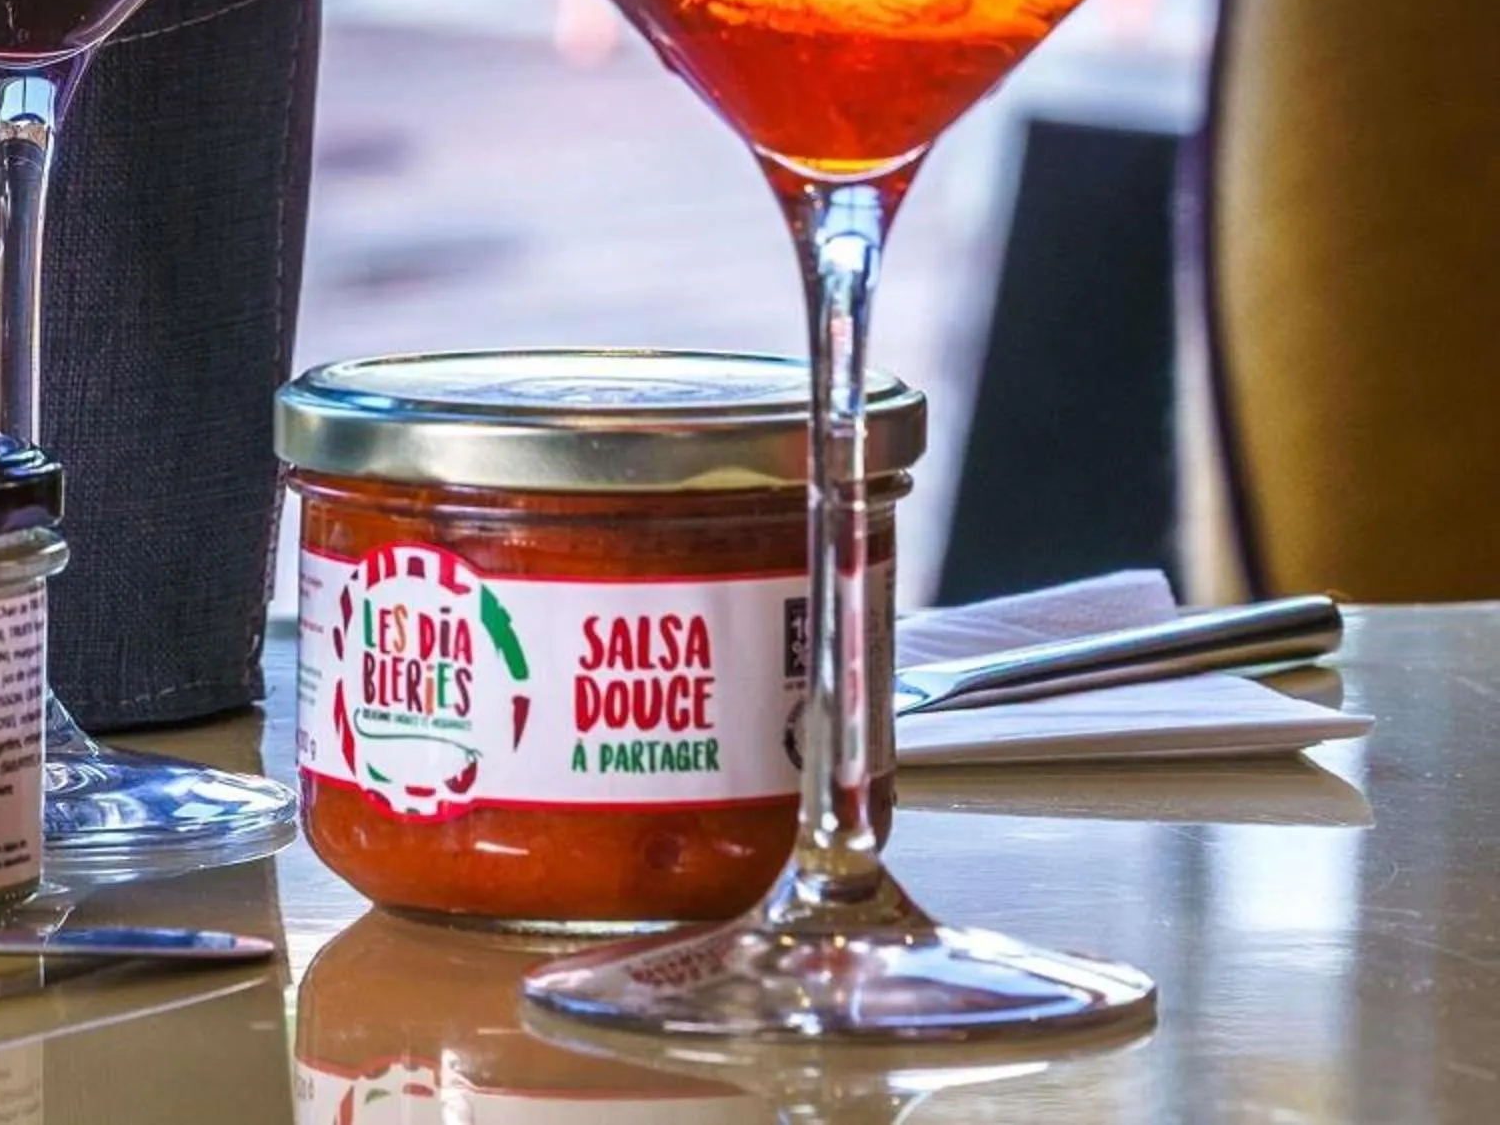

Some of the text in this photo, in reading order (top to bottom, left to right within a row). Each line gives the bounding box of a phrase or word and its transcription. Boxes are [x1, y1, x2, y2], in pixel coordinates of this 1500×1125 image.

[363, 597, 408, 654] LES
[579, 614, 711, 671] SALSA
[575, 675, 715, 732] DOUCE
[600, 738, 720, 773] PARTAGER
